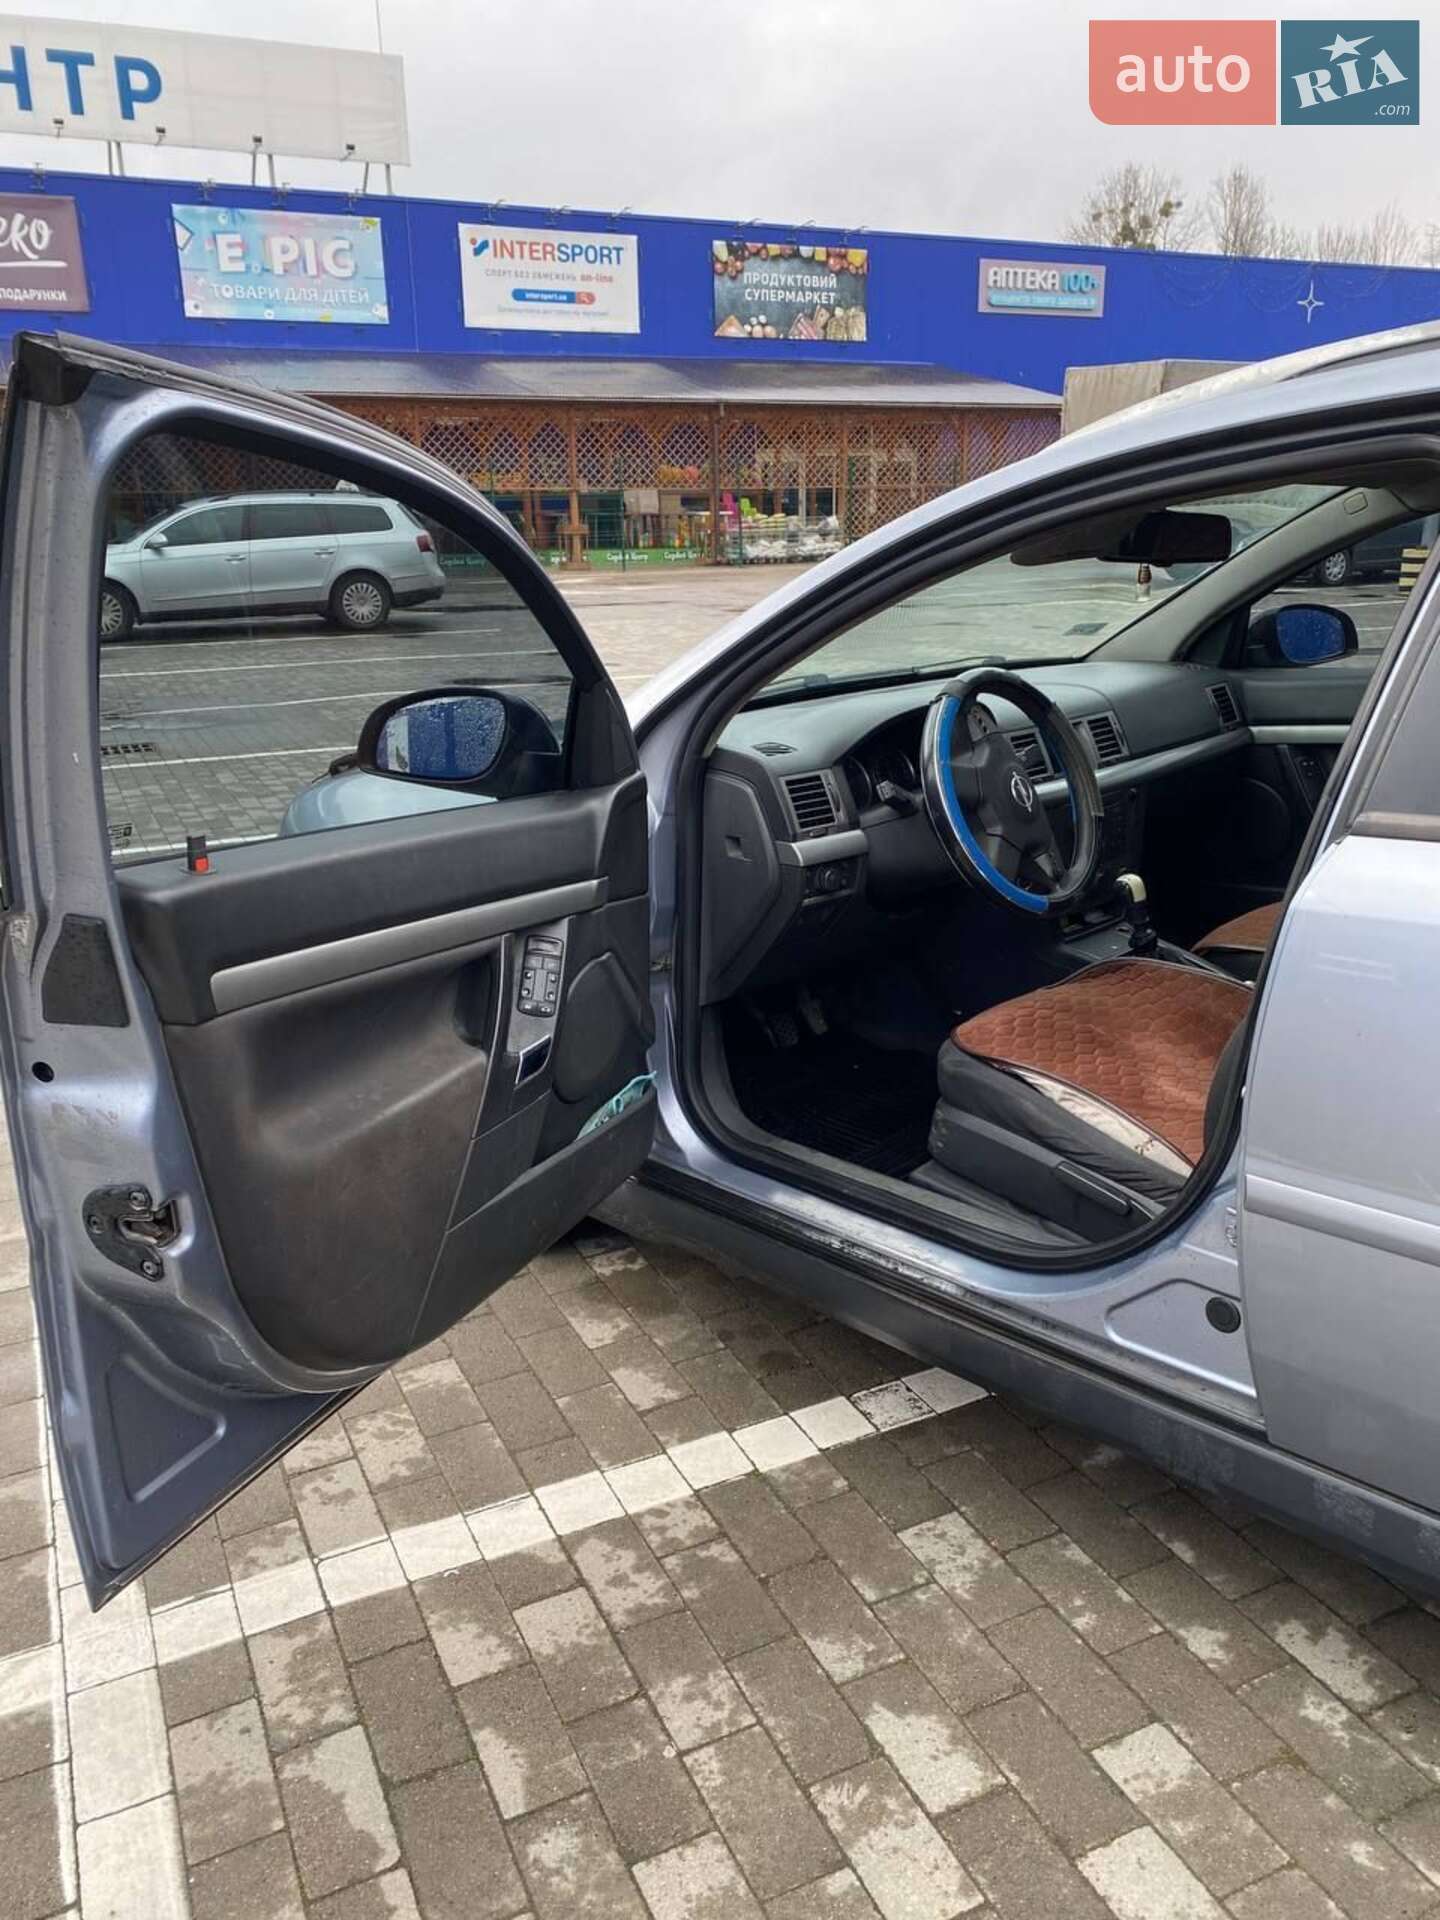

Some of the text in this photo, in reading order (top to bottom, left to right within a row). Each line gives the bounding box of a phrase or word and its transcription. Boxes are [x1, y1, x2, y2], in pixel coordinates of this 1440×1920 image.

[492, 238, 624, 265] INTERSPORT
[743, 272, 837, 289] ПРОДУКТОВИЙ
[988, 267, 1059, 291] АПТЕКА
[211, 284, 369, 304] ТОВАРИ ДЛЯ ДІТЕЙ
[744, 288, 836, 305] СУПЕРМАРКЕТ
